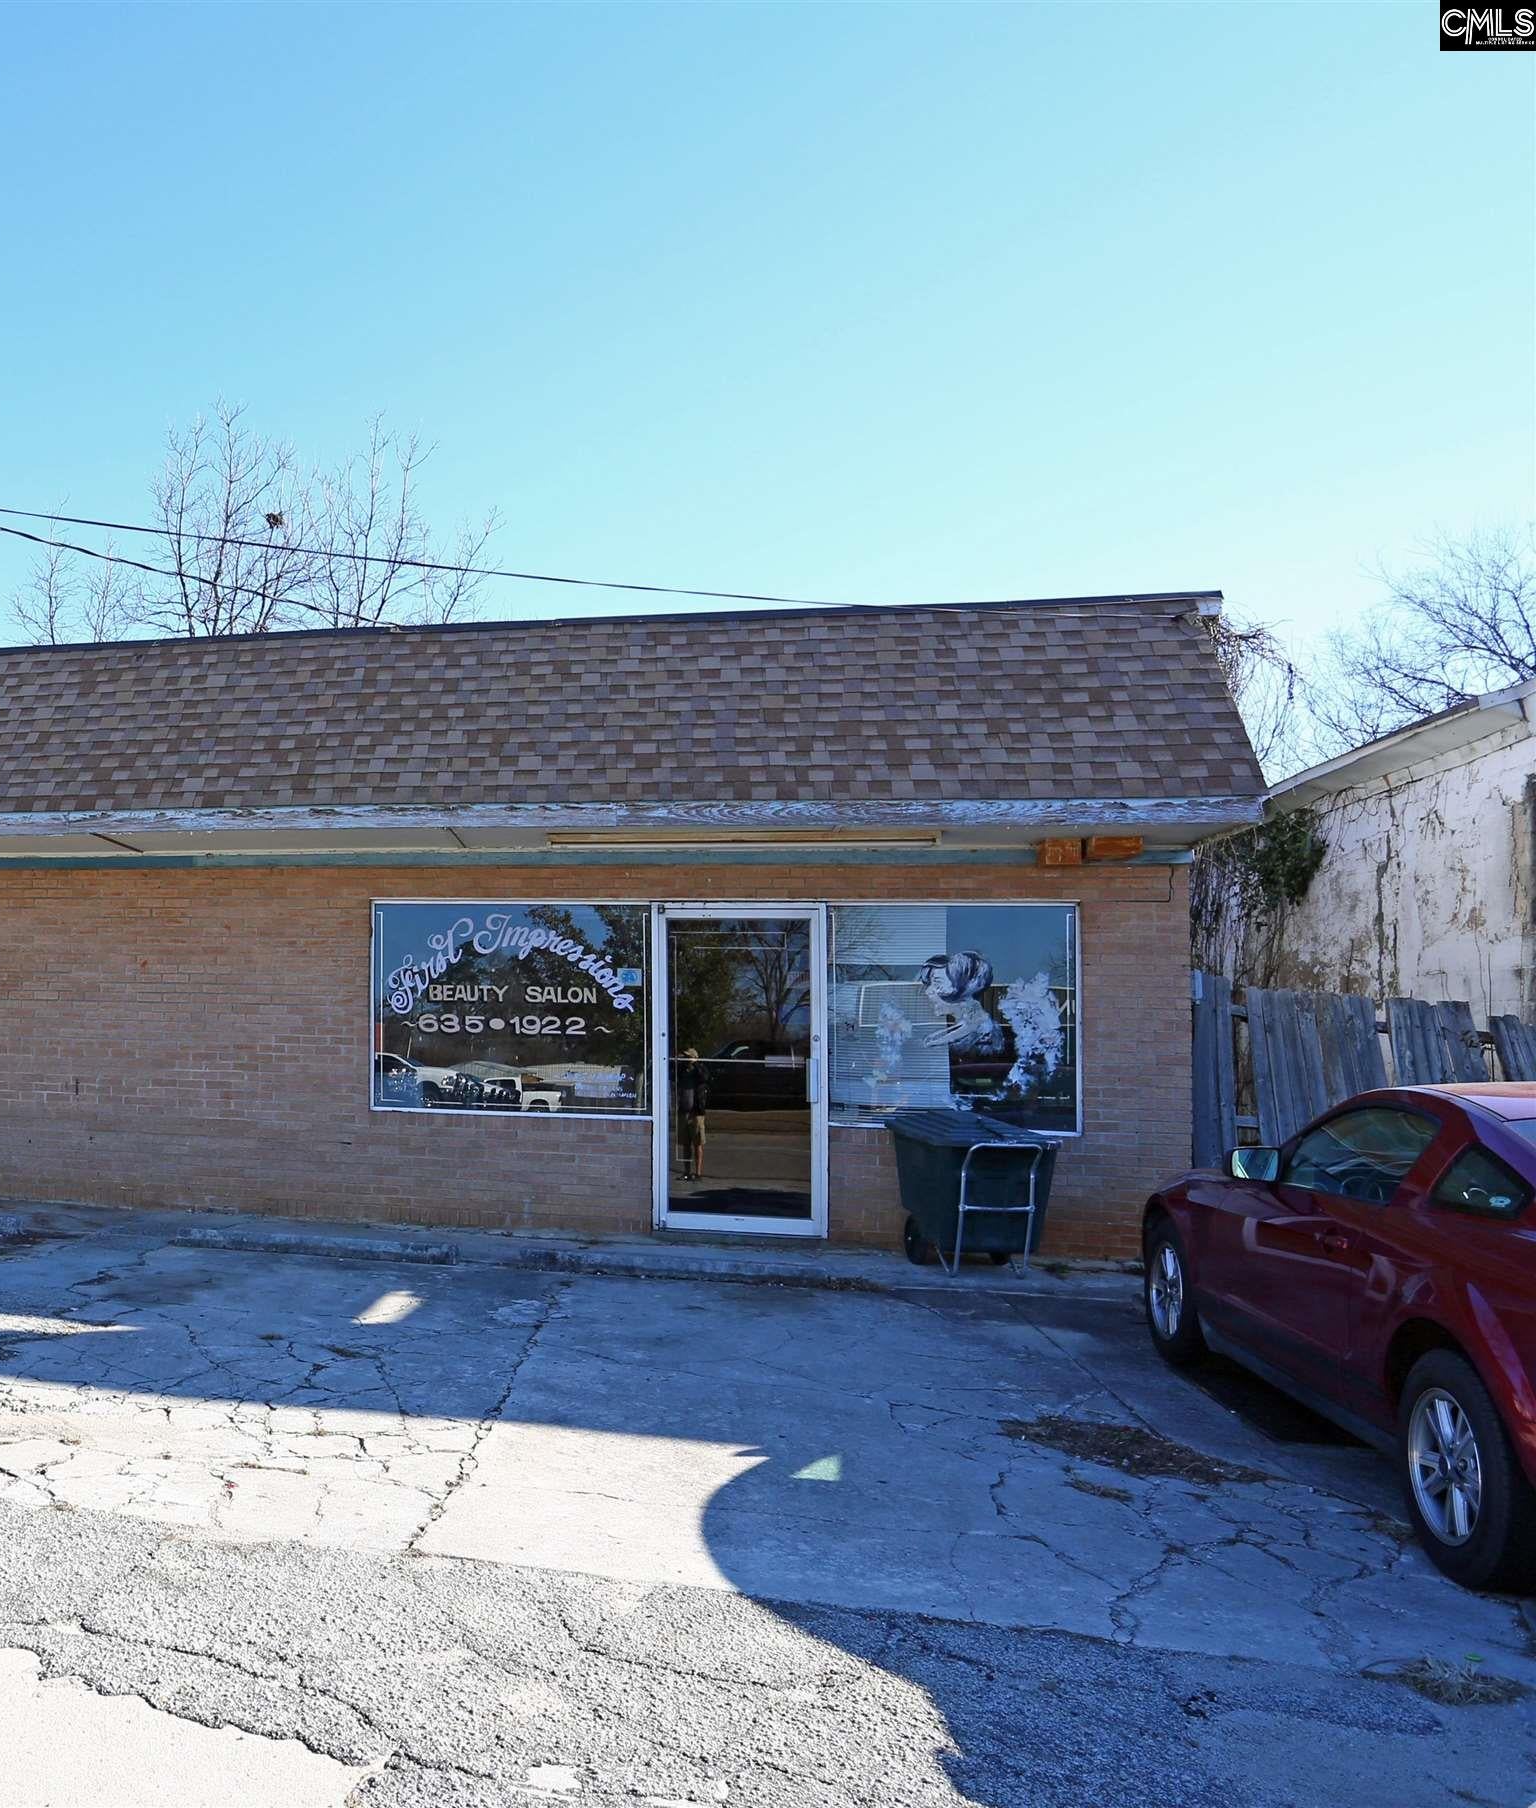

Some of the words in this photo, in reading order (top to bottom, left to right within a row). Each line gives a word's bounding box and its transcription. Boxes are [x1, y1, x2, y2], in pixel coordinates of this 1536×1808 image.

[387, 917, 474, 1014] First
[473, 913, 634, 1013] Impressions
[428, 984, 509, 1003] BEAUTY
[525, 985, 598, 1004] SALON
